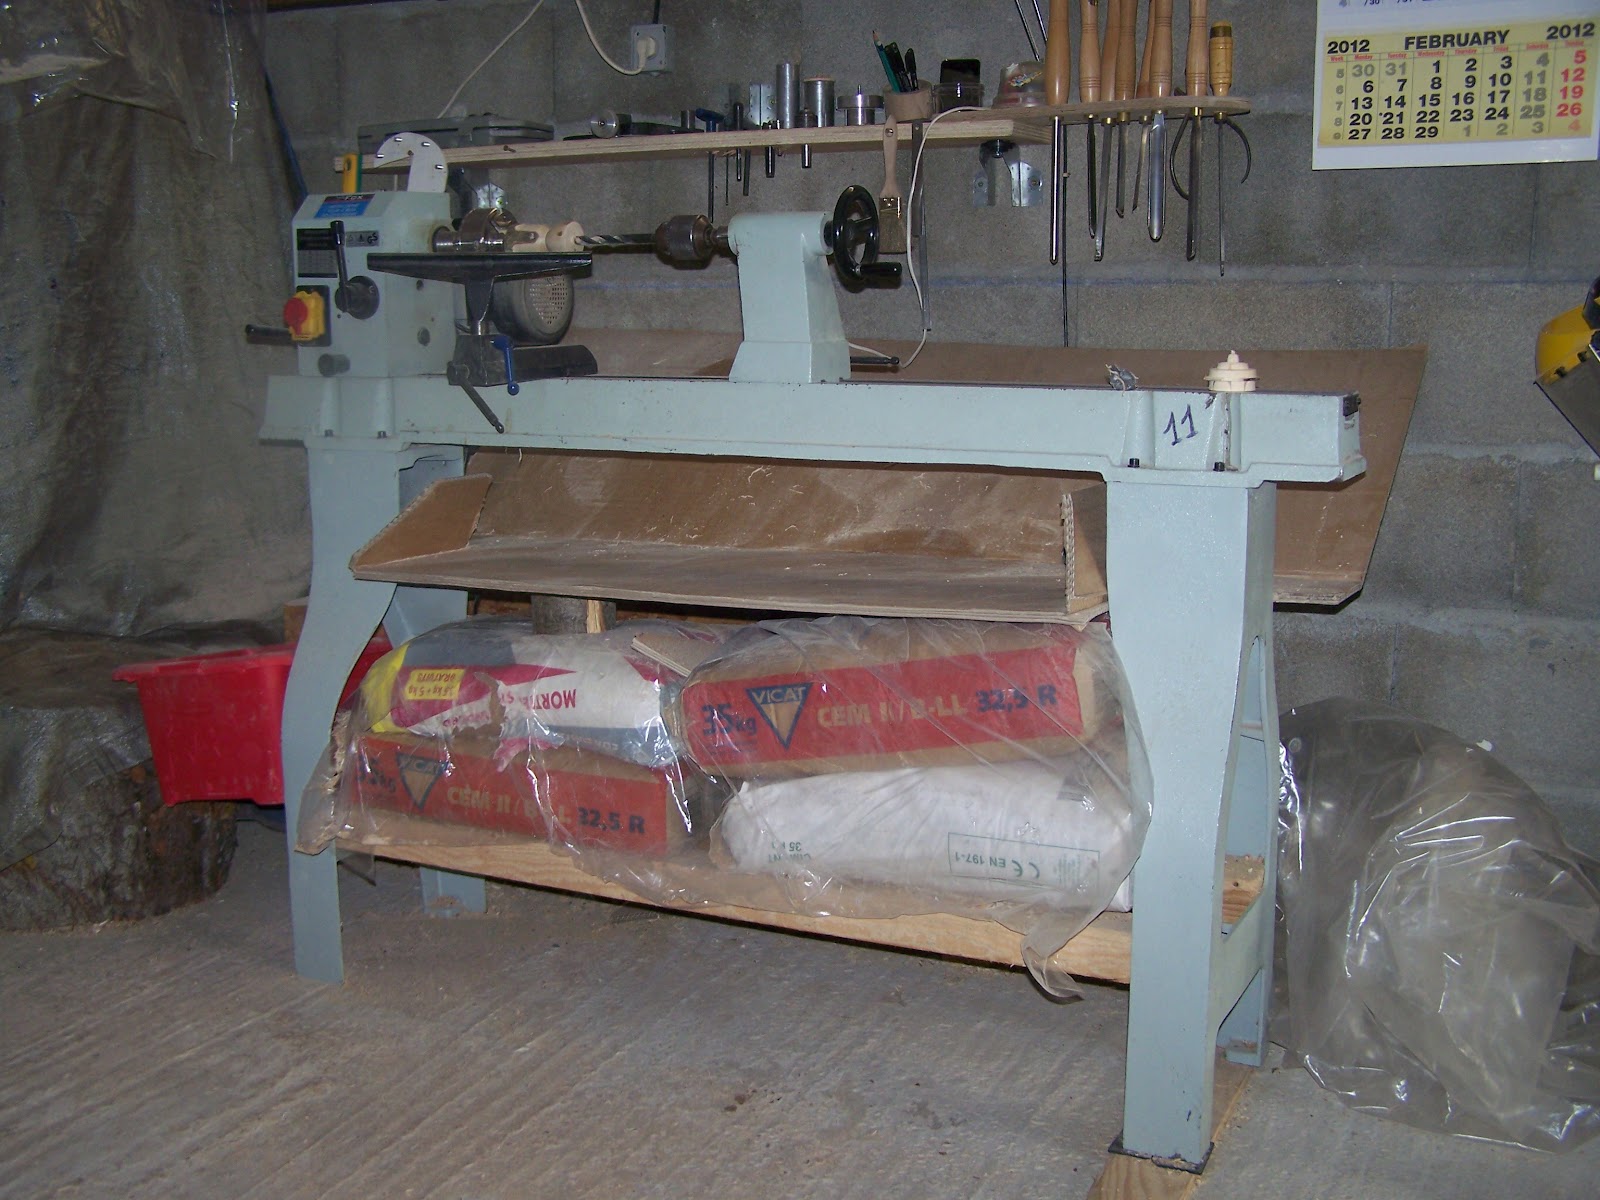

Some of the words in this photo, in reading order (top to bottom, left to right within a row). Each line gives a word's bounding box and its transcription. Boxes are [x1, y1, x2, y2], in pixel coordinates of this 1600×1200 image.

[1327, 39, 1370, 54] 2012
[1404, 30, 1510, 50] FEBRUARY
[1546, 23, 1595, 40] 2012
[1336, 68, 1344, 78] 5
[1352, 64, 1375, 77] 30
[1385, 62, 1406, 75] 31
[1432, 60, 1440, 73] 1
[1465, 58, 1477, 71] 2
[1500, 55, 1512, 69] 3
[1536, 52, 1549, 67] 4
[1574, 49, 1587, 64] 5
[1336, 85, 1344, 95] 6
[1363, 80, 1374, 93] 6
[1397, 79, 1407, 91] 7
[1430, 77, 1442, 90] 8
[1465, 75, 1476, 88] 9
[1488, 73, 1512, 87] 10
[1524, 70, 1546, 85] 11
[1561, 67, 1585, 83] 12
[1335, 101, 1343, 111] 7
[1351, 97, 1373, 110] 13
[1384, 95, 1406, 108] 14
[1418, 94, 1440, 107] 15
[1452, 92, 1474, 105] 16
[1487, 90, 1510, 104] 17
[1522, 87, 1546, 102] 18
[1559, 85, 1583, 99] 19
[1334, 117, 1342, 126] 8
[1349, 113, 1372, 126] 20
[1382, 112, 1404, 124] 21
[1415, 110, 1440, 123] 22
[1450, 108, 1474, 121] 23
[1484, 107, 1509, 120] 24
[1520, 104, 1545, 119] 25
[1555, 103, 1582, 117] 26
[1348, 129, 1371, 140] 27
[1381, 127, 1405, 139] 28
[1414, 126, 1439, 138] 29
[1463, 125, 1471, 137] 1
[1496, 123, 1508, 135] 2
[1531, 121, 1544, 134] 3
[1568, 119, 1581, 131] 4
[1163, 404, 1198, 446] 11
[751, 686, 806, 703] VICAT
[817, 703, 872, 728] CEM
[976, 687, 1028, 713] 32,5
[1037, 684, 1057, 707] R
[578, 806, 620, 832] 32,5
[629, 815, 645, 834] R
[955, 851, 984, 865] 197-1
[989, 856, 1006, 868] EN
